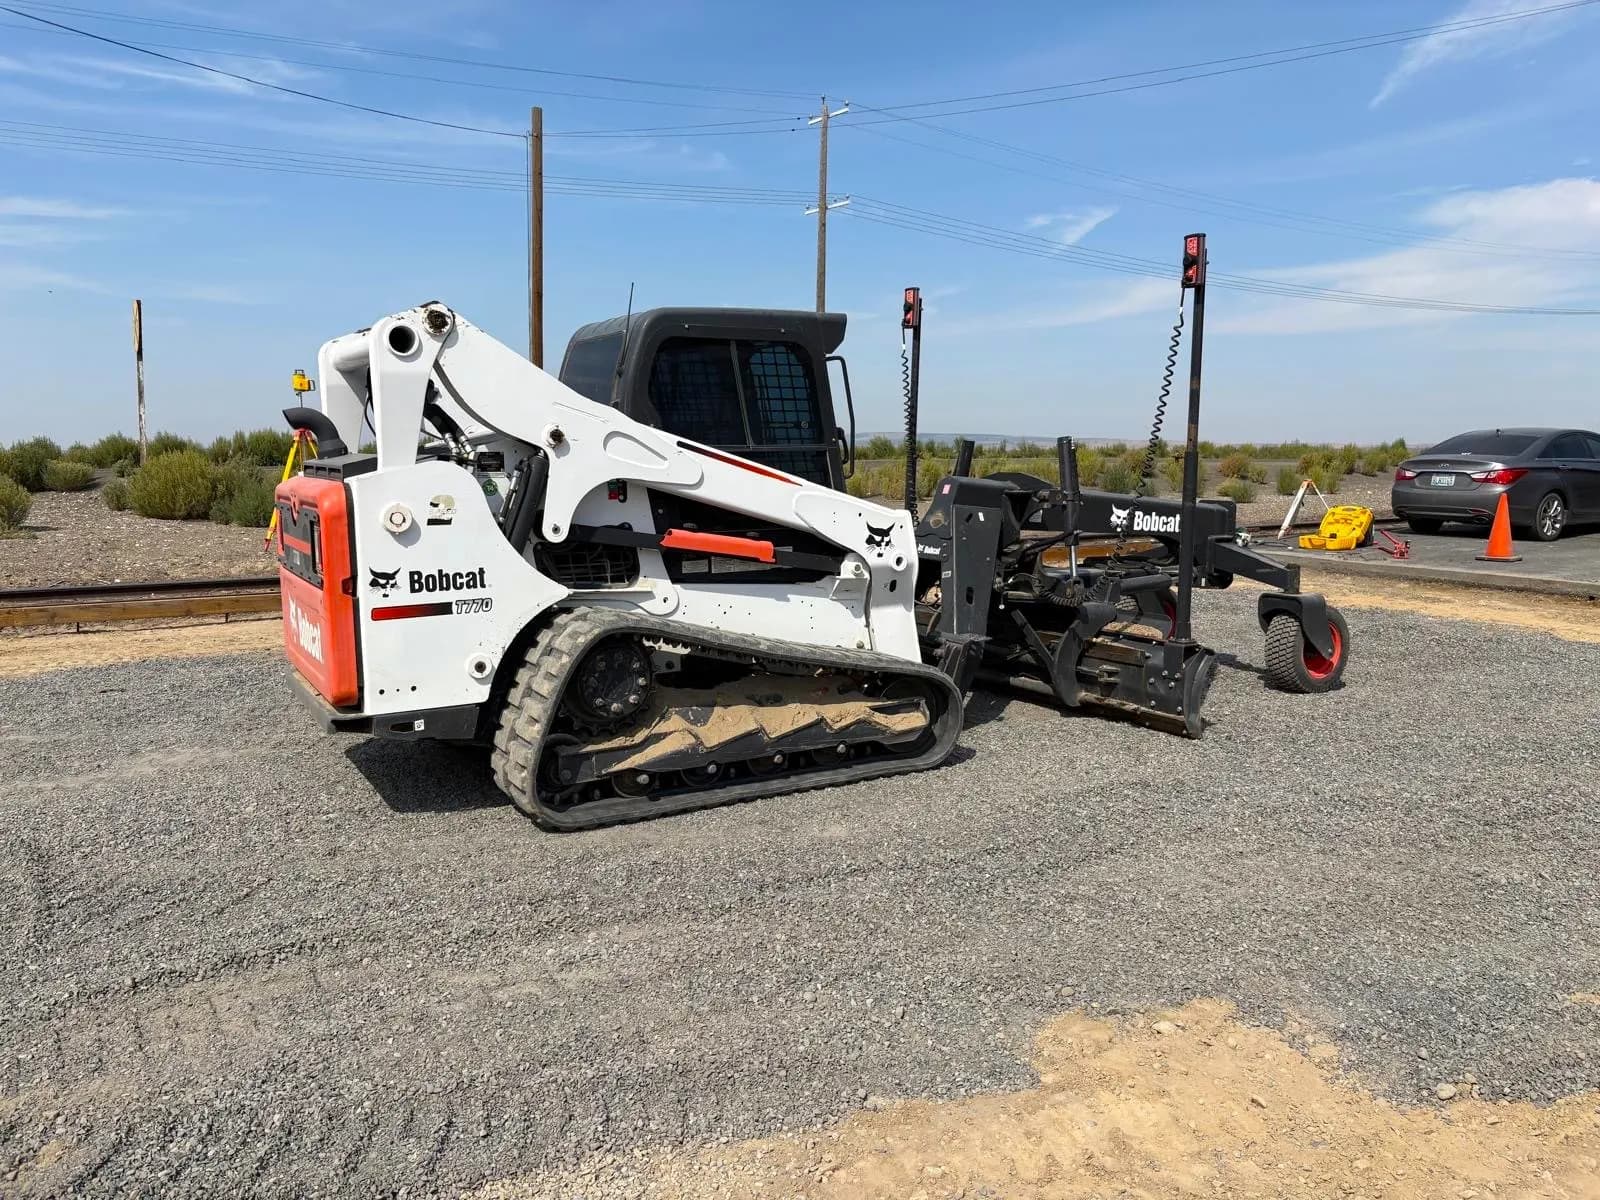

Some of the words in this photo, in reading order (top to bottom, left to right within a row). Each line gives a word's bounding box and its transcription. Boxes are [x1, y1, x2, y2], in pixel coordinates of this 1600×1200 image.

[1133, 510, 1181, 533] Bobcat
[408, 567, 487, 594] Bobcat
[455, 597, 493, 615] T770
[297, 607, 323, 665] Bobcat
